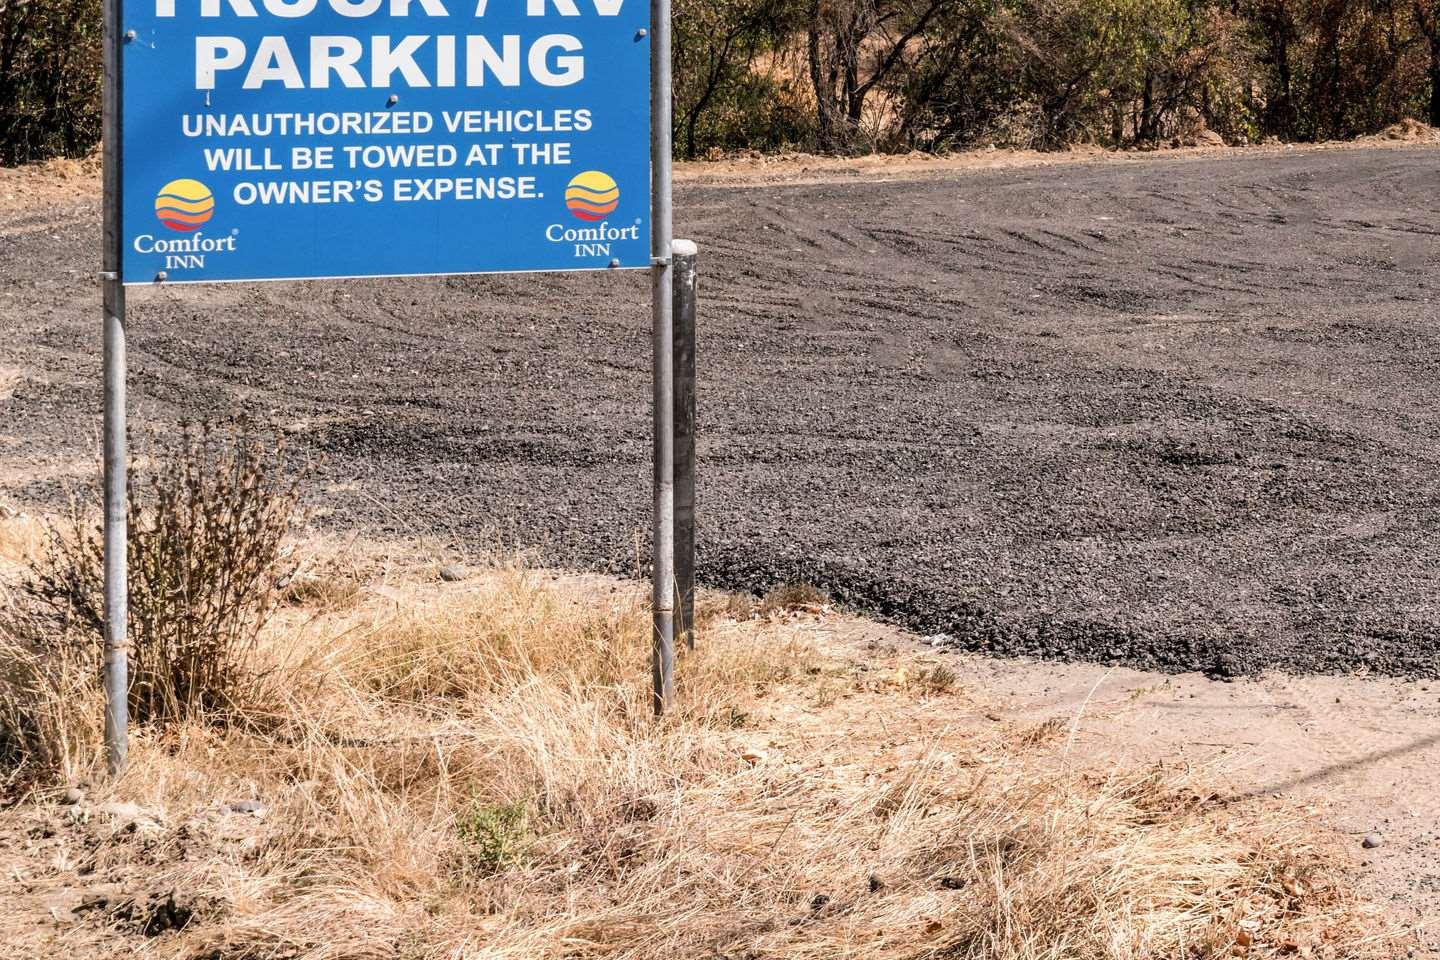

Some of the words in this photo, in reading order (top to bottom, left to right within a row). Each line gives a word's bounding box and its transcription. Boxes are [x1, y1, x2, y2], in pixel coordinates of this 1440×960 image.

[196, 34, 584, 89] PARKING
[183, 112, 432, 136] UNAUTHORIZED
[442, 109, 592, 132] VEHICLES
[204, 148, 282, 171] WILL
[292, 147, 333, 169] BE
[344, 145, 457, 168] TOWED
[465, 144, 503, 166] AT
[512, 143, 571, 164] THE
[234, 180, 383, 205] OWNER’S
[394, 177, 543, 201] EXPENSE.
[165, 254, 205, 269] INN
[574, 243, 611, 256] INN
